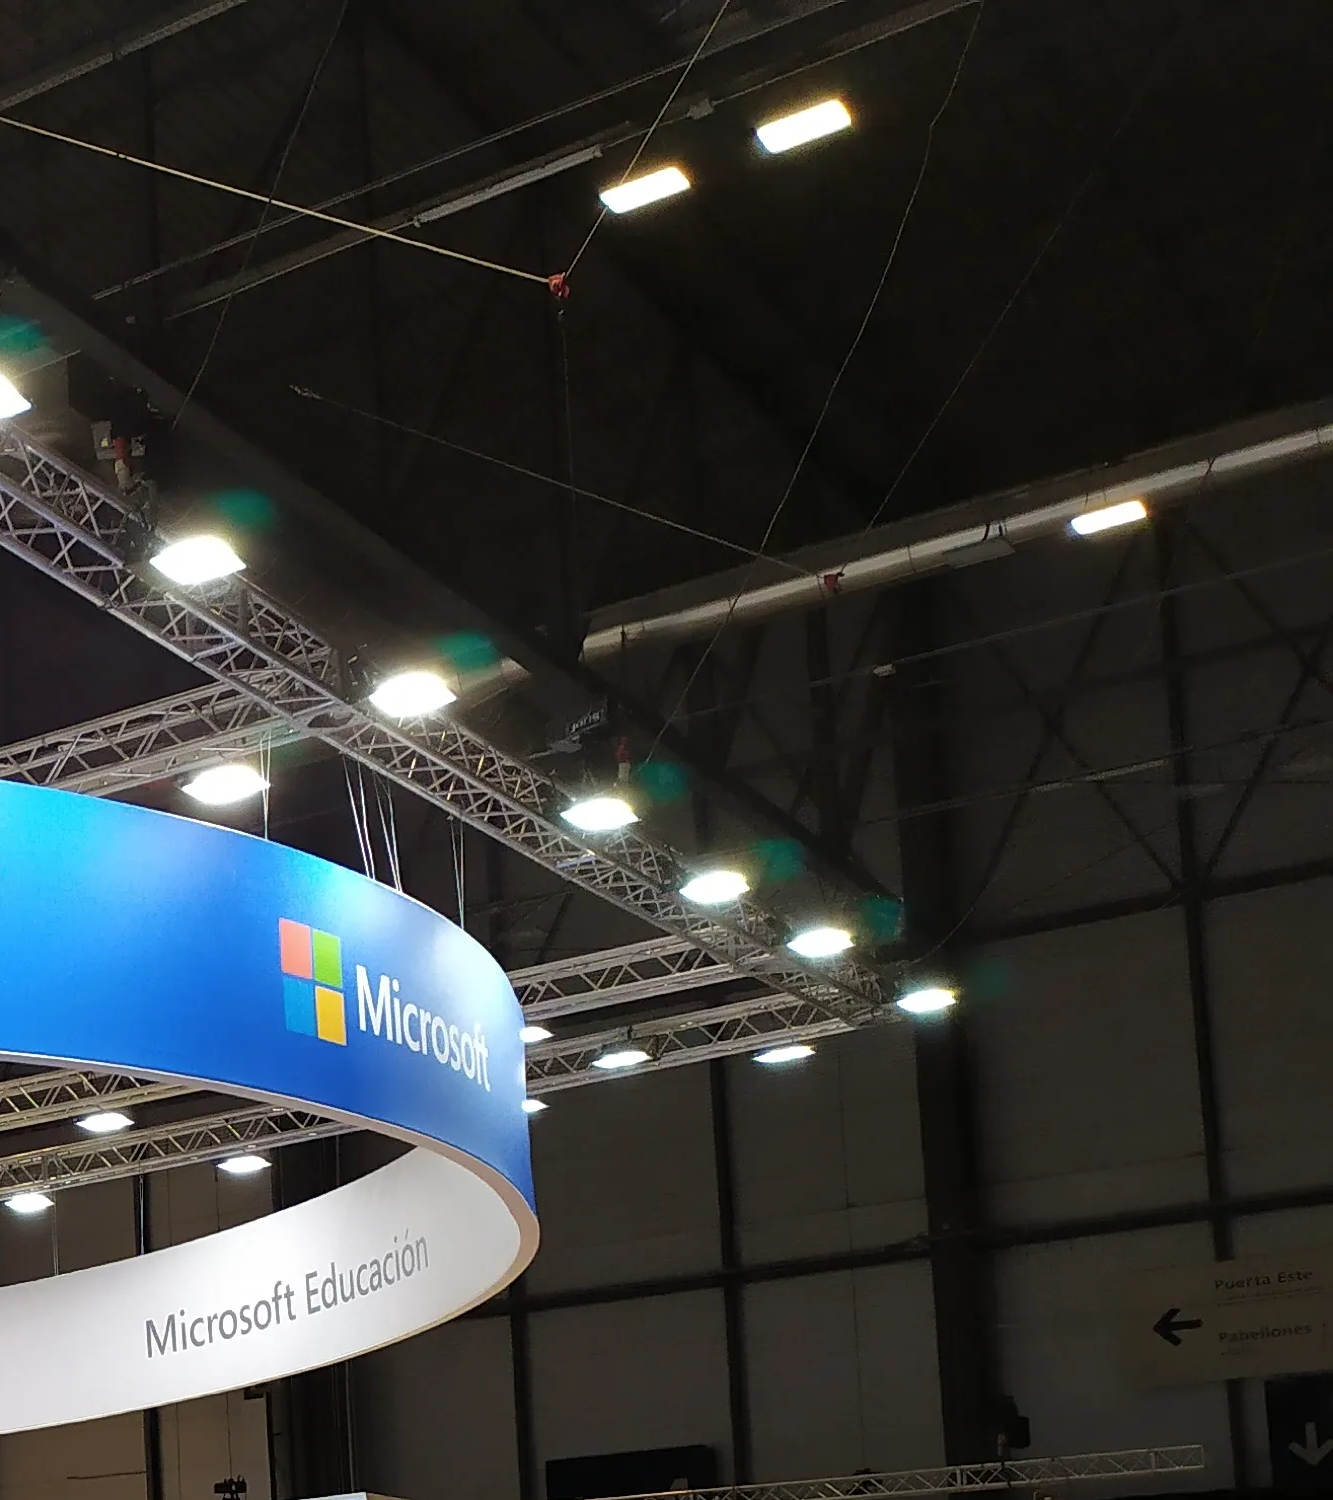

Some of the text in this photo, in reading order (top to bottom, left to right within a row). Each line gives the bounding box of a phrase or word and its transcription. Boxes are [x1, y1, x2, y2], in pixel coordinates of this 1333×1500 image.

[355, 964, 491, 1092] Microsoft
[144, 1228, 429, 1358] Microsoft Educación
